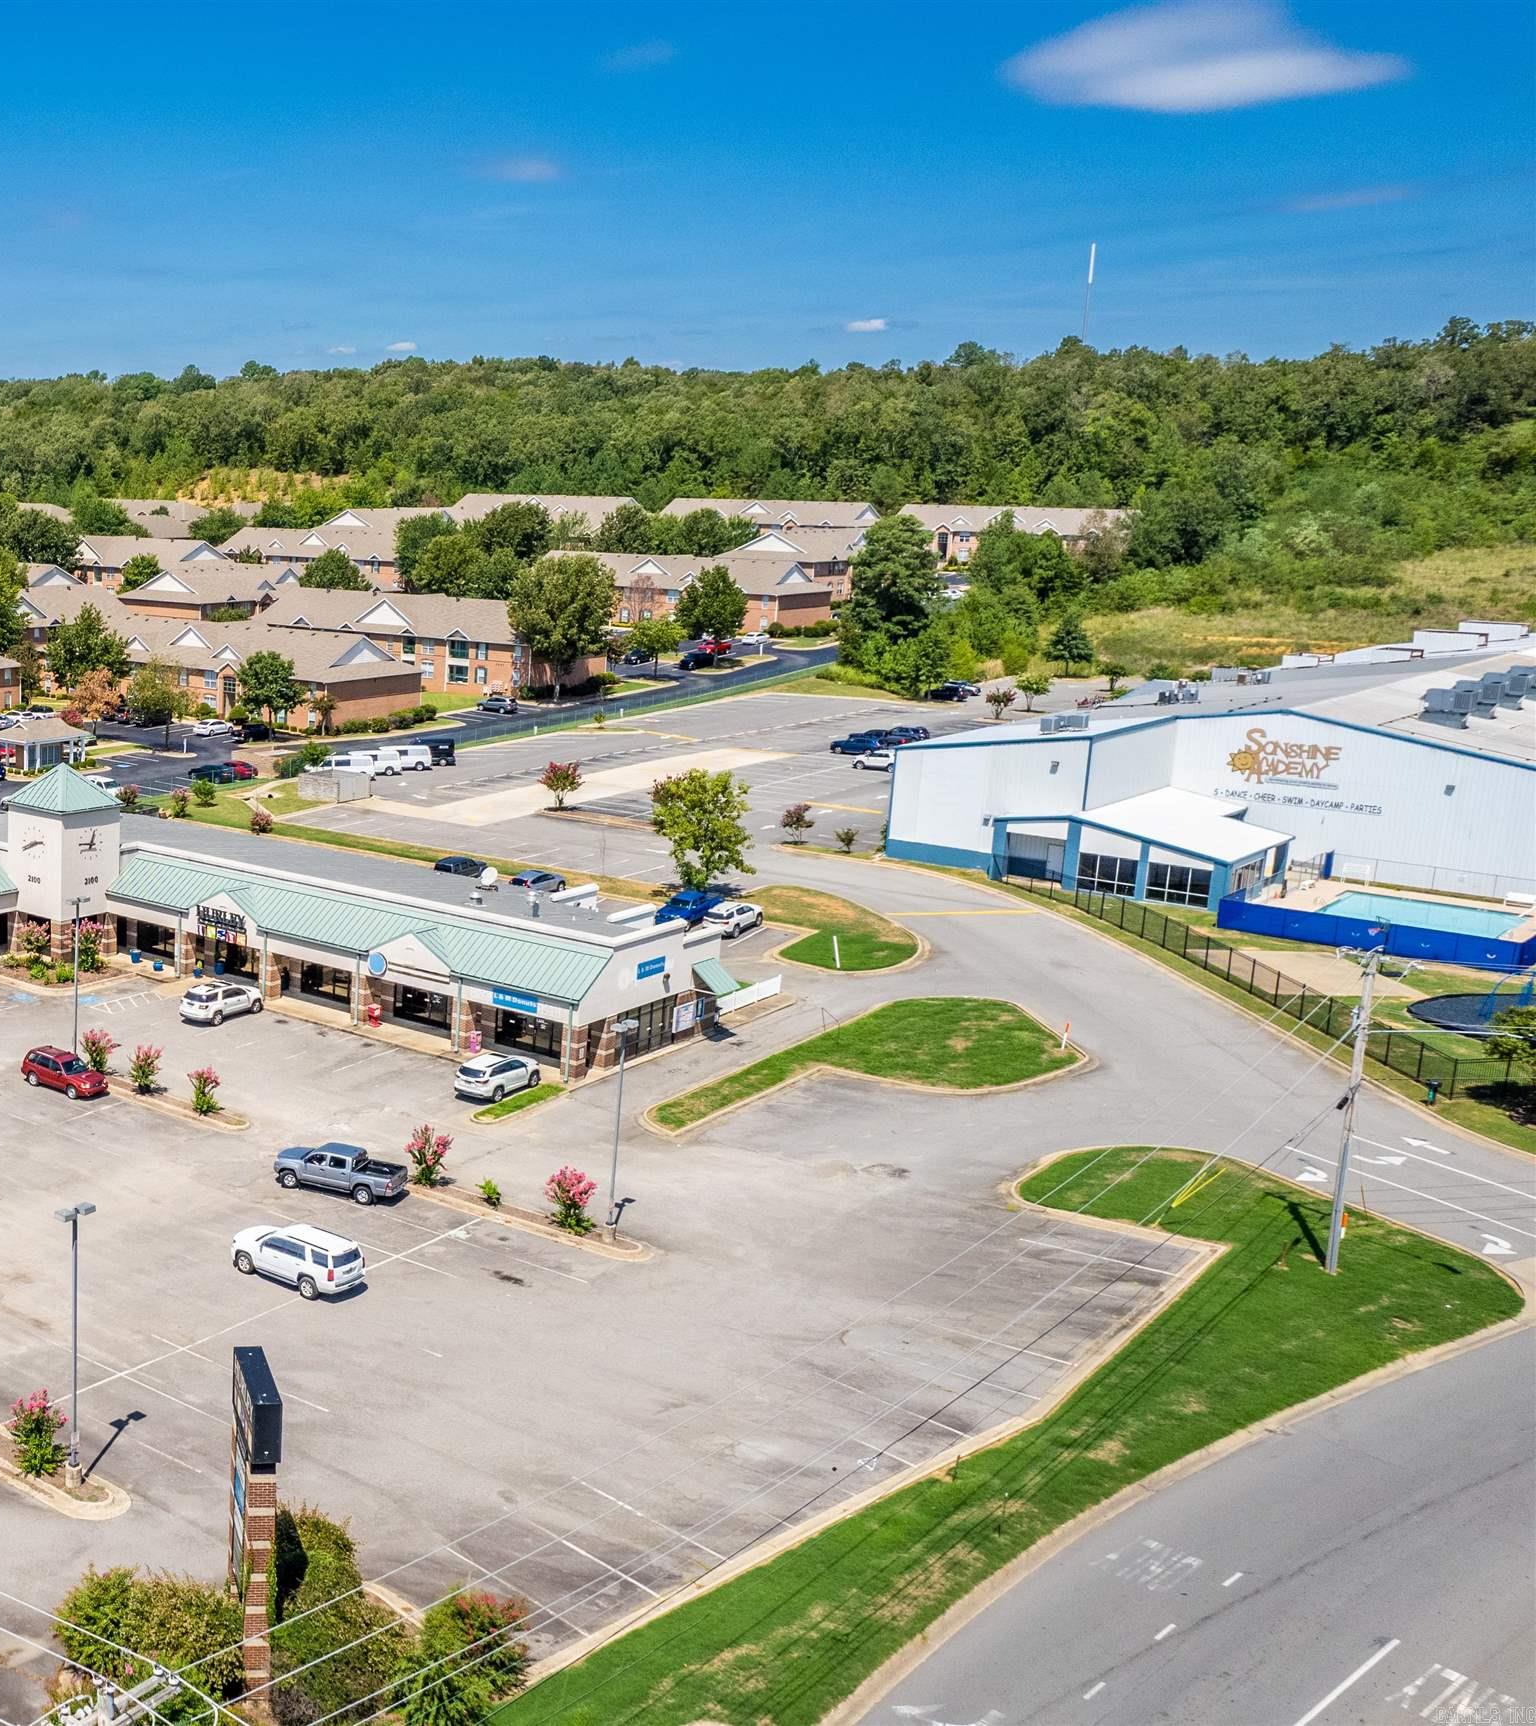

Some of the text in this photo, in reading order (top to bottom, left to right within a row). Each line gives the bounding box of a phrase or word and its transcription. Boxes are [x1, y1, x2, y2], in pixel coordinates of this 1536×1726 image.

[1245, 727, 1342, 761] SONSHINE
[1244, 756, 1330, 784] ACADEMY
[1225, 789, 1249, 799] DANCE
[1254, 792, 1276, 802] CHEER
[1282, 795, 1303, 805] SWIM
[1310, 799, 1344, 809] DAYCAMP
[1350, 803, 1383, 815] PARTIES
[28, 875, 41, 884] 2100
[84, 876, 98, 885] 2100
